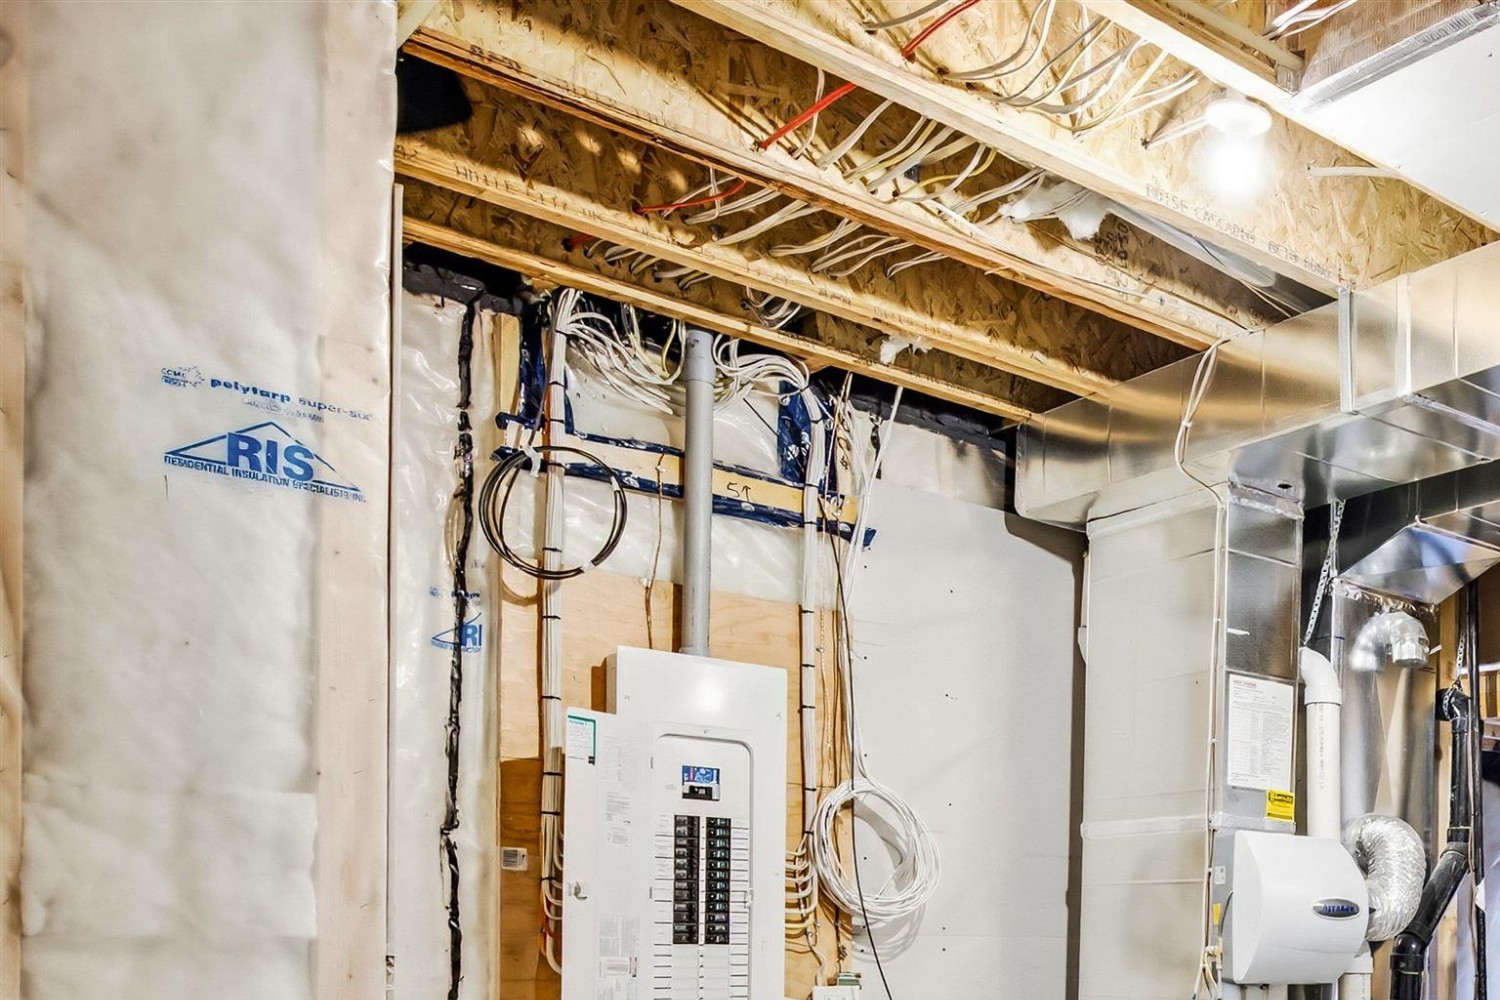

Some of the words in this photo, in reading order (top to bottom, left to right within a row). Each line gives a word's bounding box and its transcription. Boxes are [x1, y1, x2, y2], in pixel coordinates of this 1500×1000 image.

[164, 455, 229, 476] RESIDENTIAL
[231, 467, 289, 487] INSULATION
[227, 432, 314, 482] RIS
